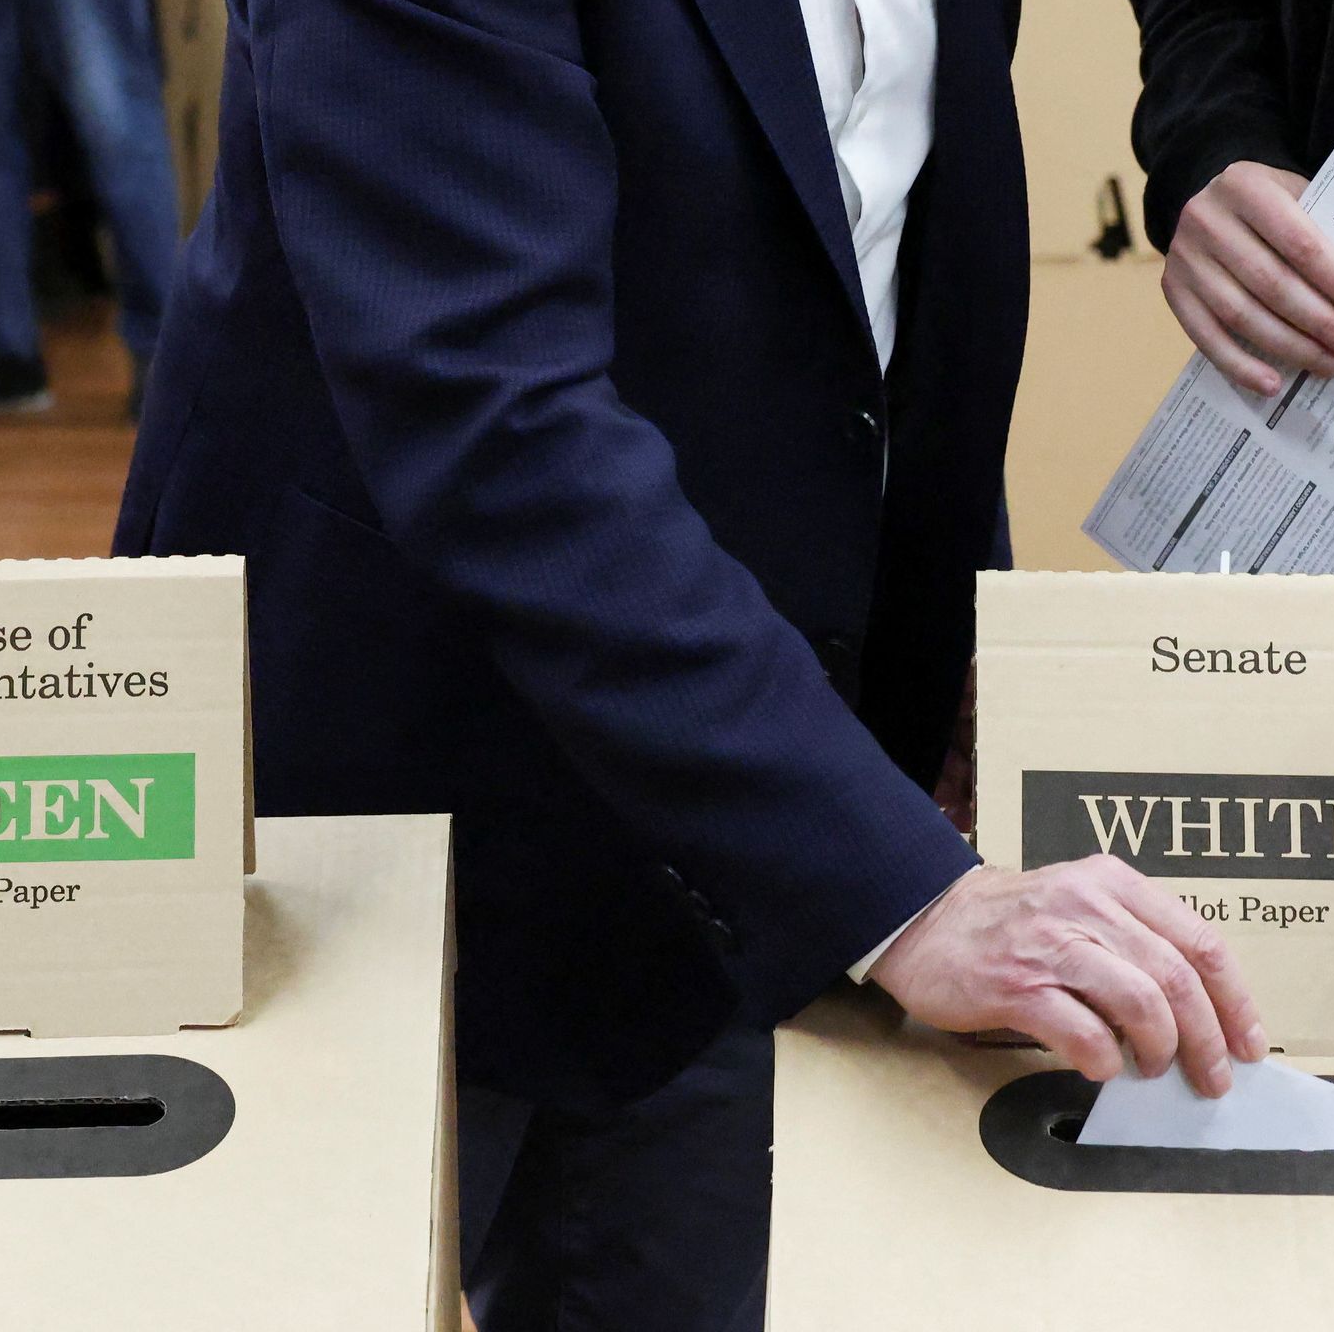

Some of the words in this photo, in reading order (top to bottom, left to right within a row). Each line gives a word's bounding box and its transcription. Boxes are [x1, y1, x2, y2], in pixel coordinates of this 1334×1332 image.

[48, 613, 93, 651] of
[1151, 636, 1308, 675] Senate
[1239, 897, 1329, 929] Paper
